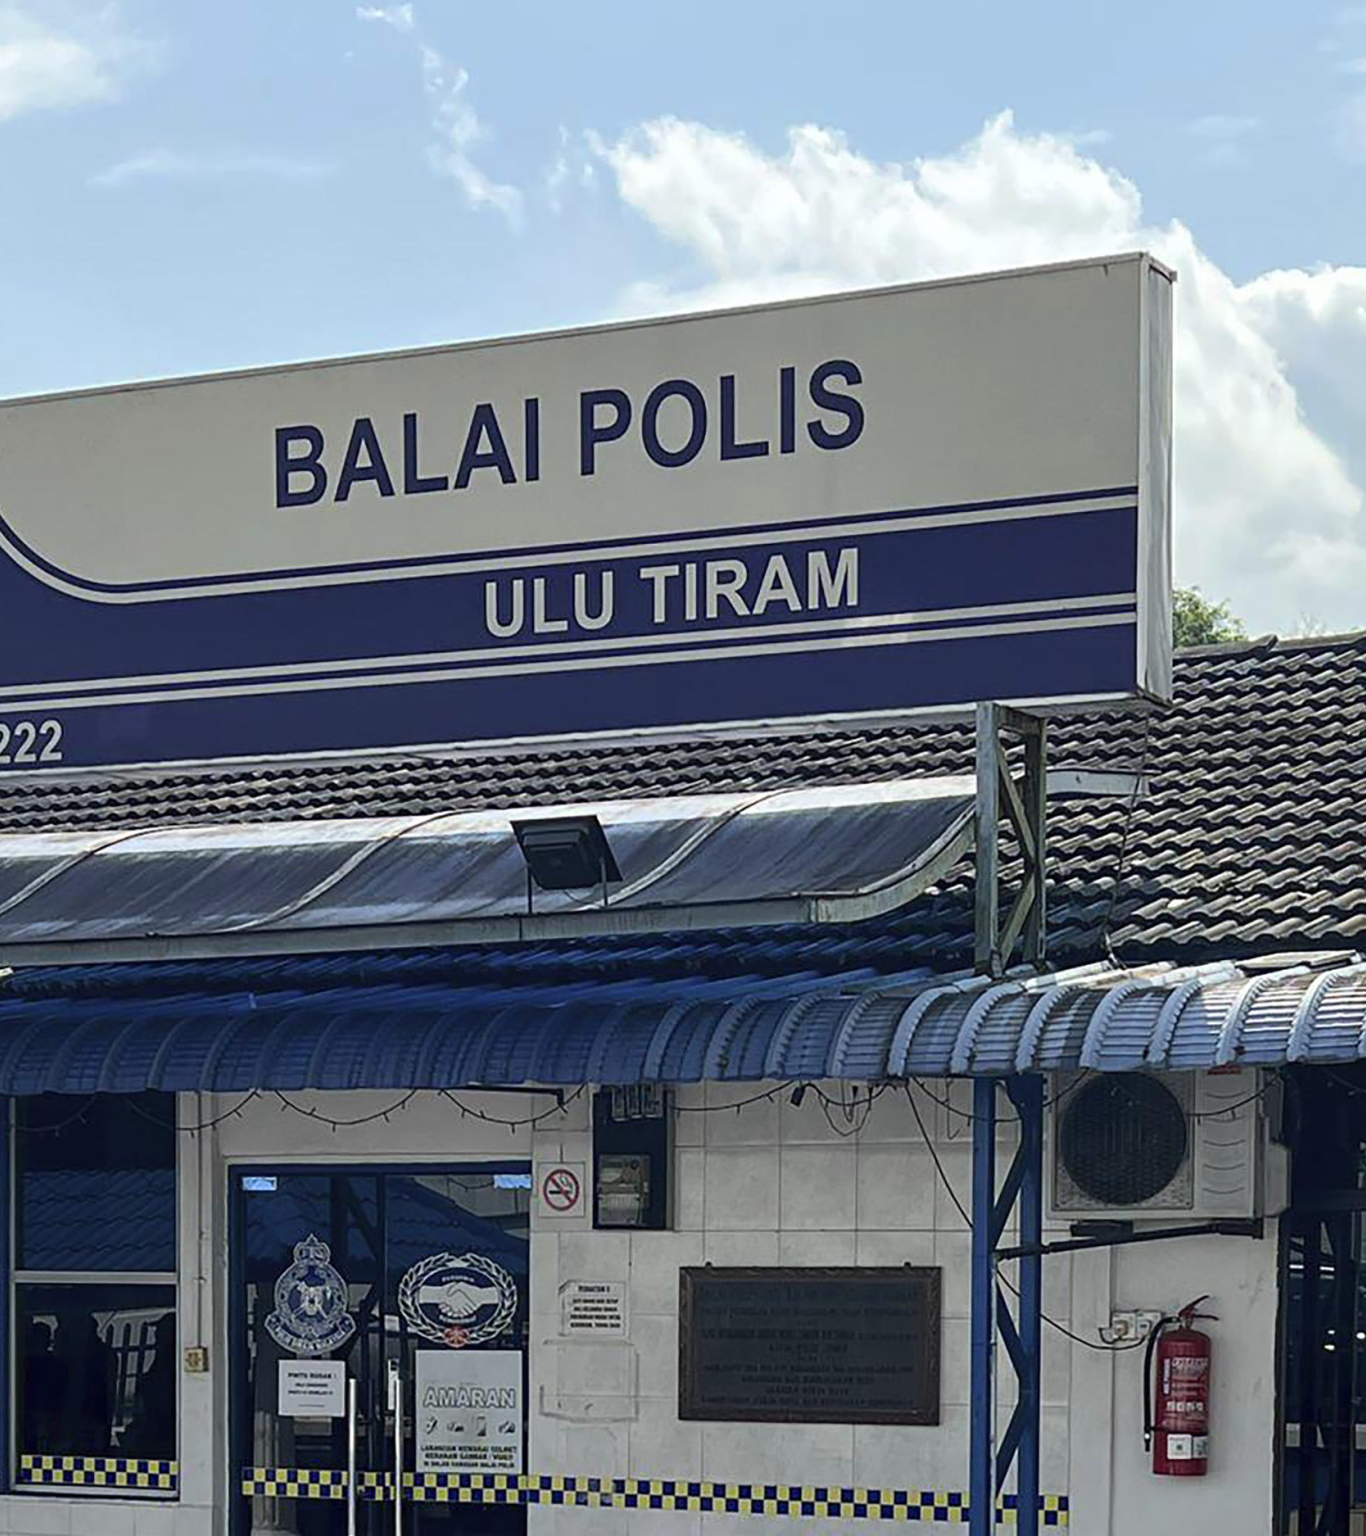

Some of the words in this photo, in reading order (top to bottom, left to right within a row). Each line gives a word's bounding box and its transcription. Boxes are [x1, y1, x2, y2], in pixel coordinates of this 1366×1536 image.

[275, 397, 539, 508] BALAI
[580, 359, 865, 477] POLIS
[485, 570, 614, 638] ULU
[640, 548, 859, 624] TIRAM
[423, 1386, 516, 1409] AMARAN
